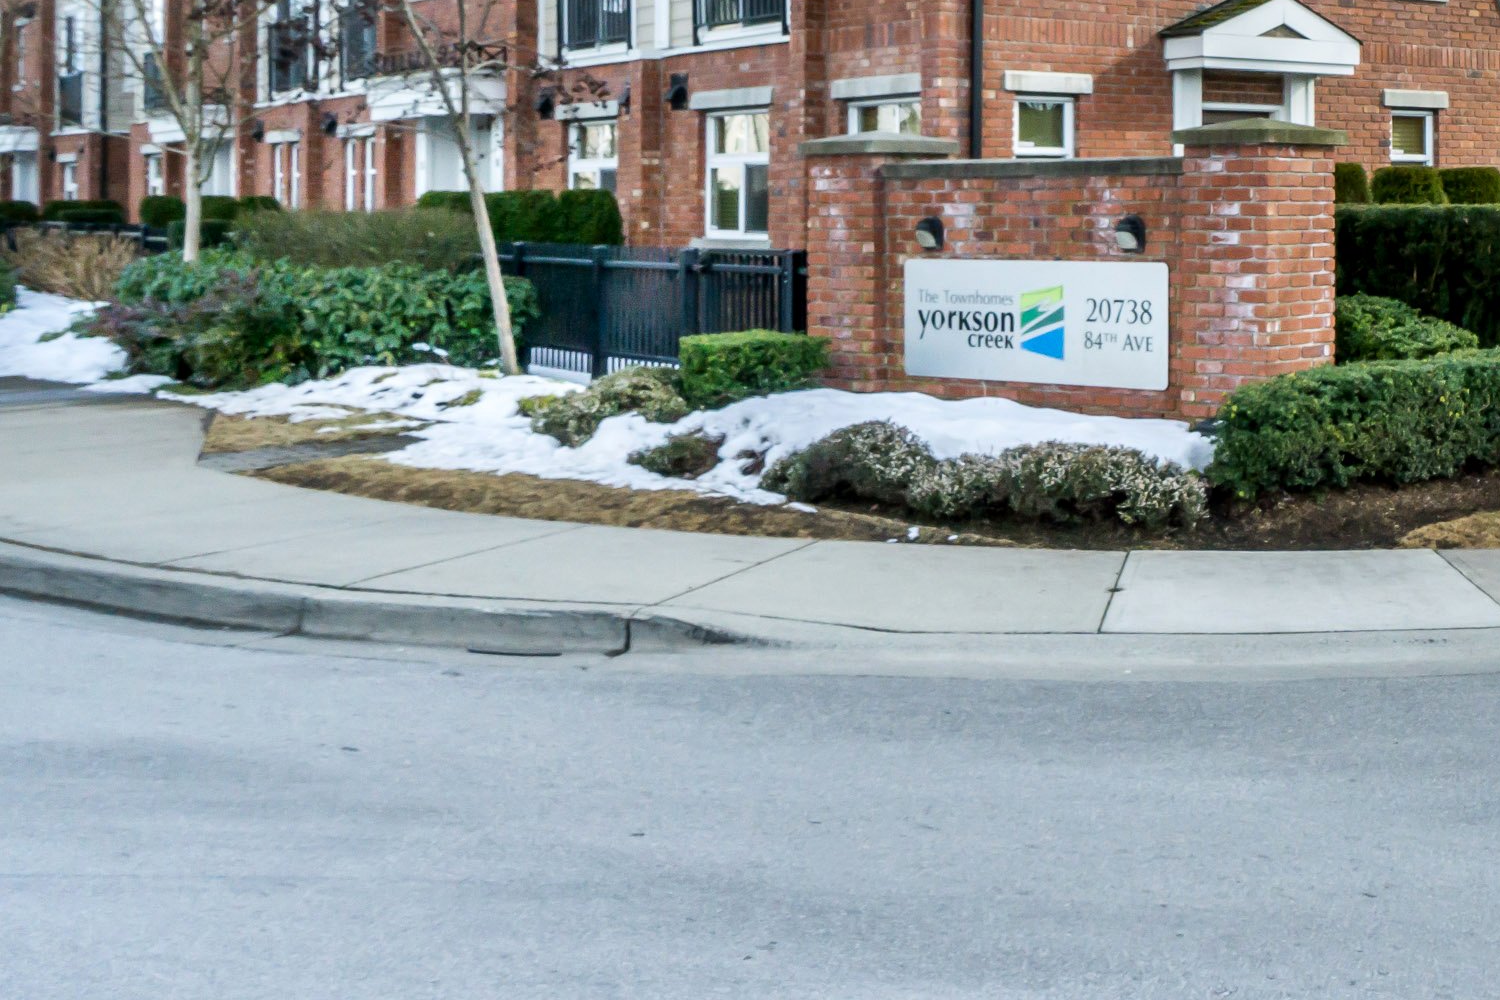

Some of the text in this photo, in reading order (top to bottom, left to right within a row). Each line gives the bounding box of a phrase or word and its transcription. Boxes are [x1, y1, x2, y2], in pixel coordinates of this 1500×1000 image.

[918, 288, 1014, 306] The Townhomes
[1086, 298, 1153, 325] 20738
[918, 309, 1015, 340] yorkson
[967, 333, 1014, 349] creek
[1122, 333, 1154, 352] AVE
